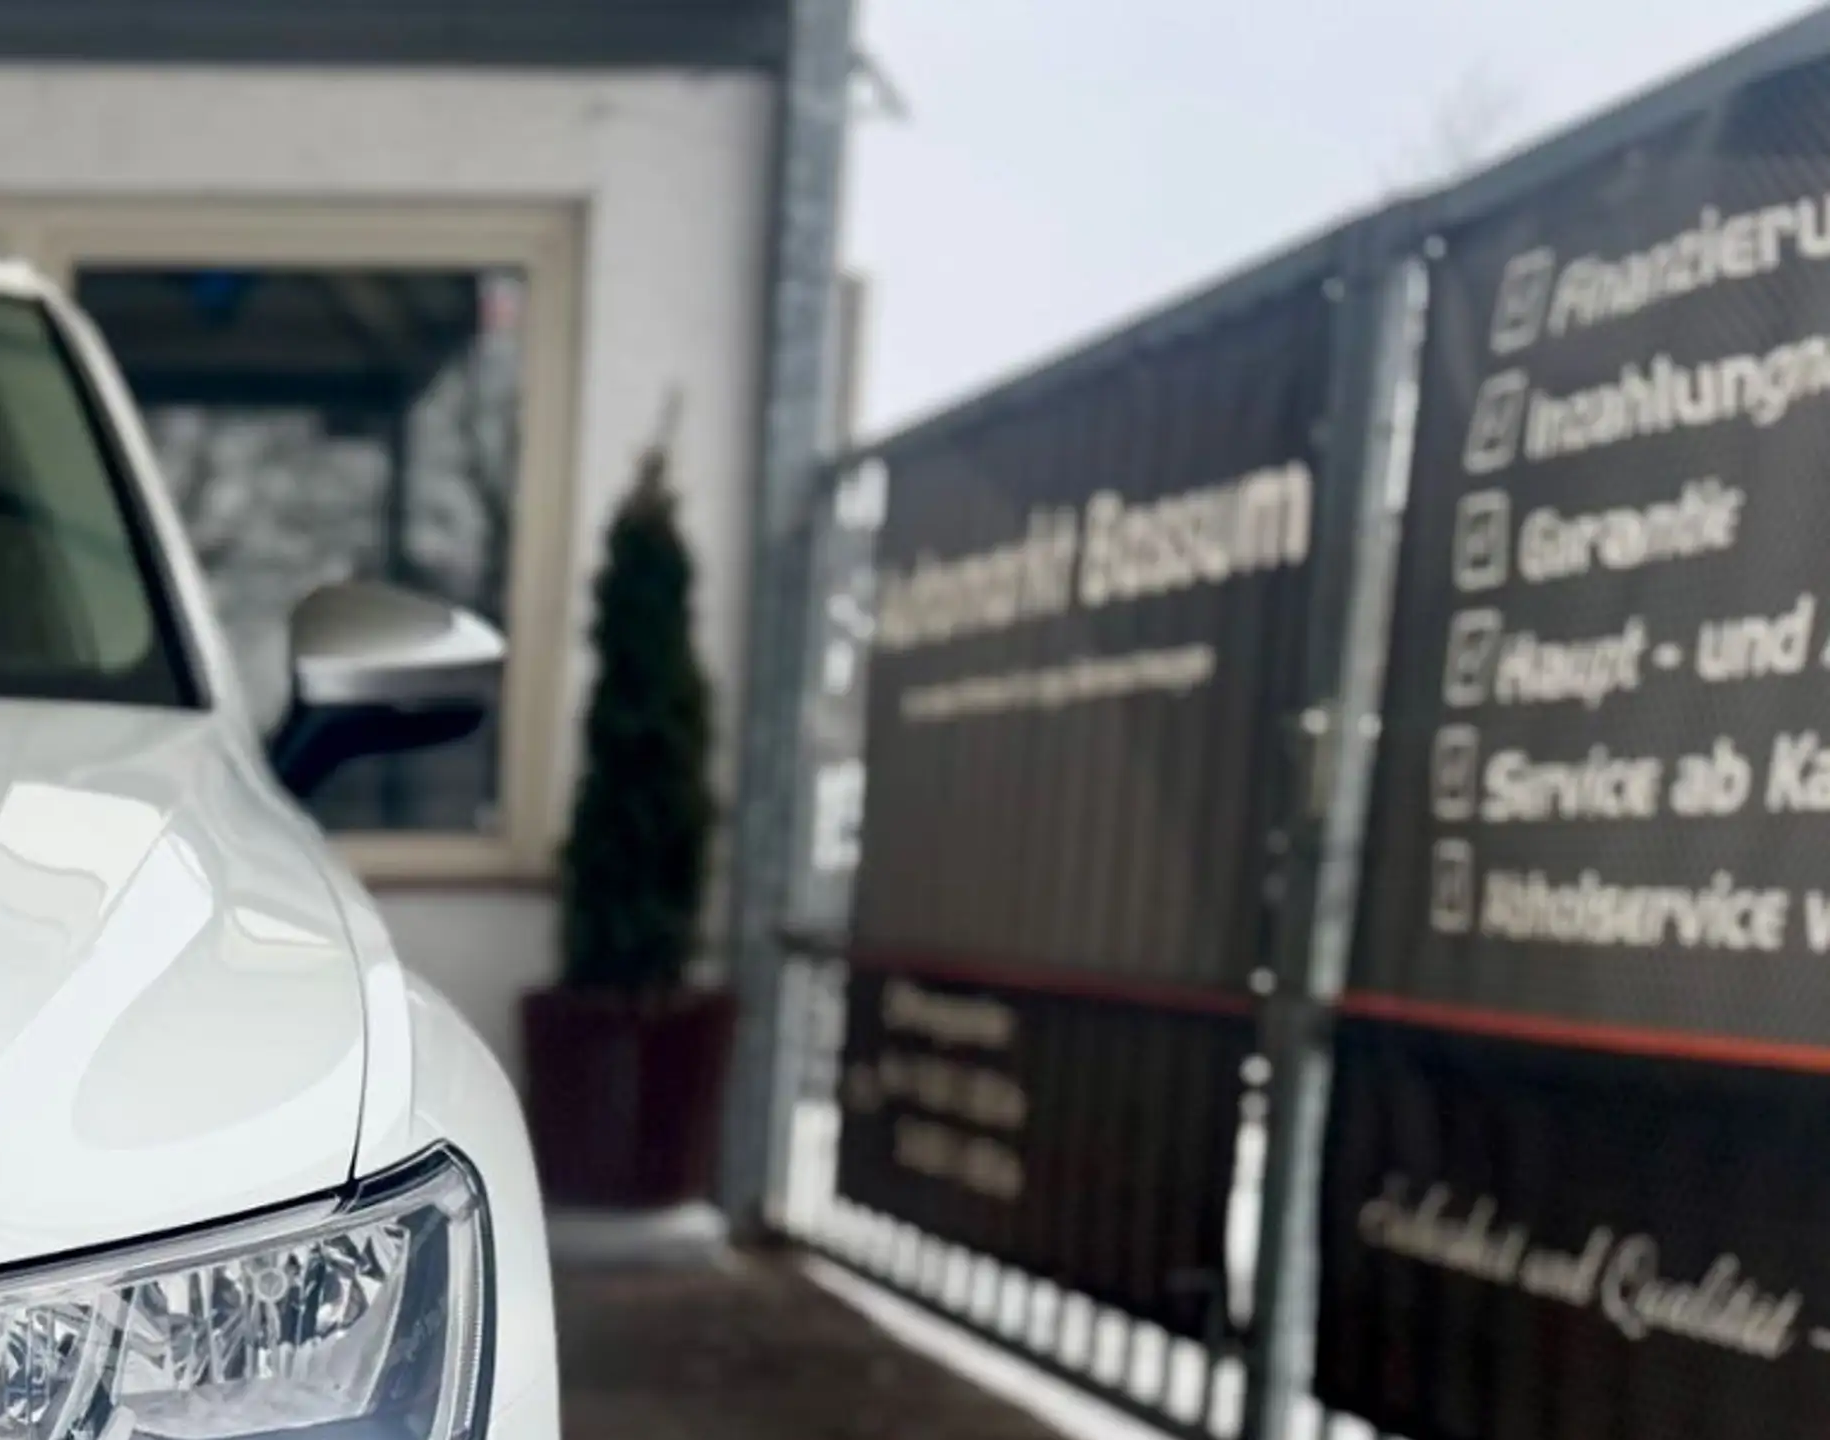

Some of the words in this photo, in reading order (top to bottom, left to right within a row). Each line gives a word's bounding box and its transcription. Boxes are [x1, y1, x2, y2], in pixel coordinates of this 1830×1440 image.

[1079, 459, 1313, 608] Bassum
[1517, 475, 1747, 584] Garantie
[1494, 615, 1646, 710] Haupt
[1694, 591, 1817, 682] und
[1480, 743, 1664, 823] Service
[1669, 734, 1753, 820] ab
